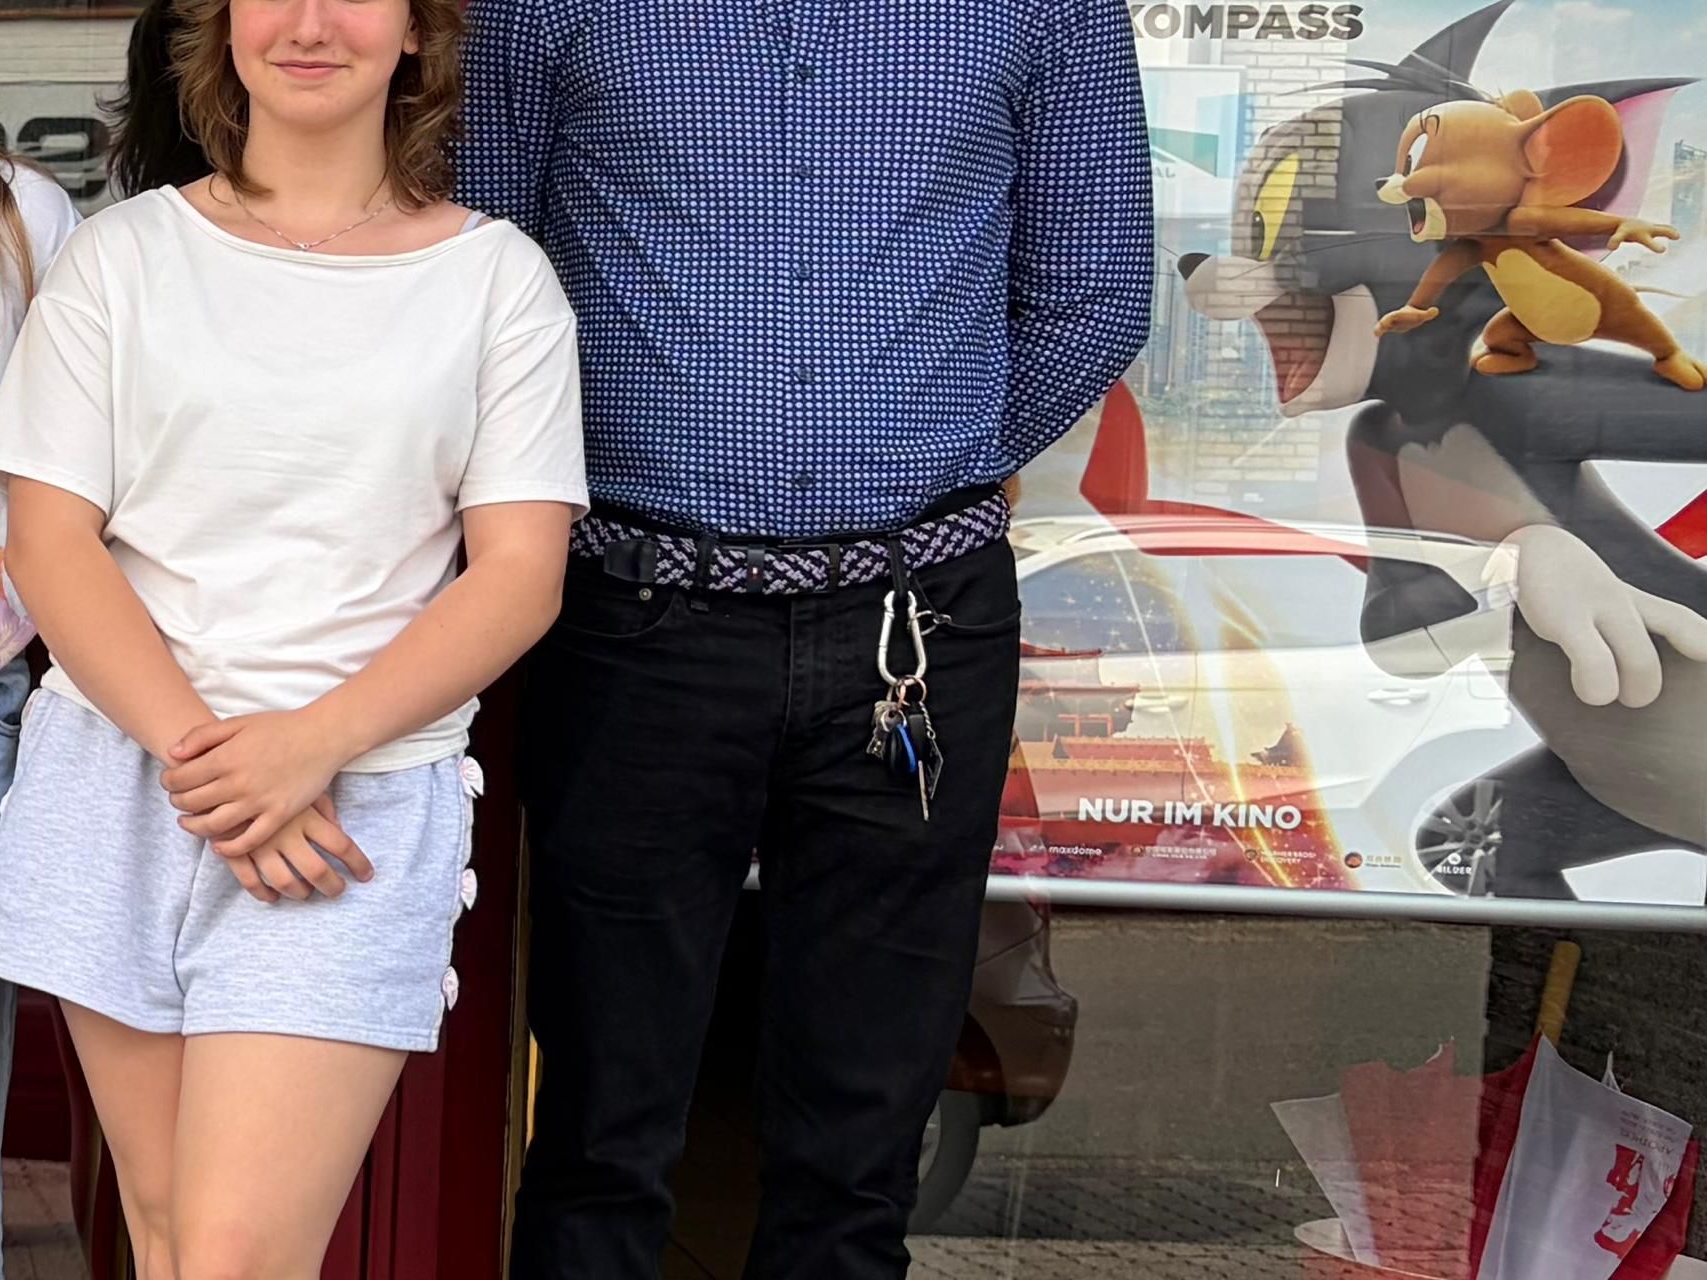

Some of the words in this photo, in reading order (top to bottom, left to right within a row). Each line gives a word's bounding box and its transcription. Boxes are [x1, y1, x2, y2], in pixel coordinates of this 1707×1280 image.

[1078, 797, 1154, 824] NUR
[1164, 800, 1203, 826] IM
[1213, 802, 1302, 830] KINO
